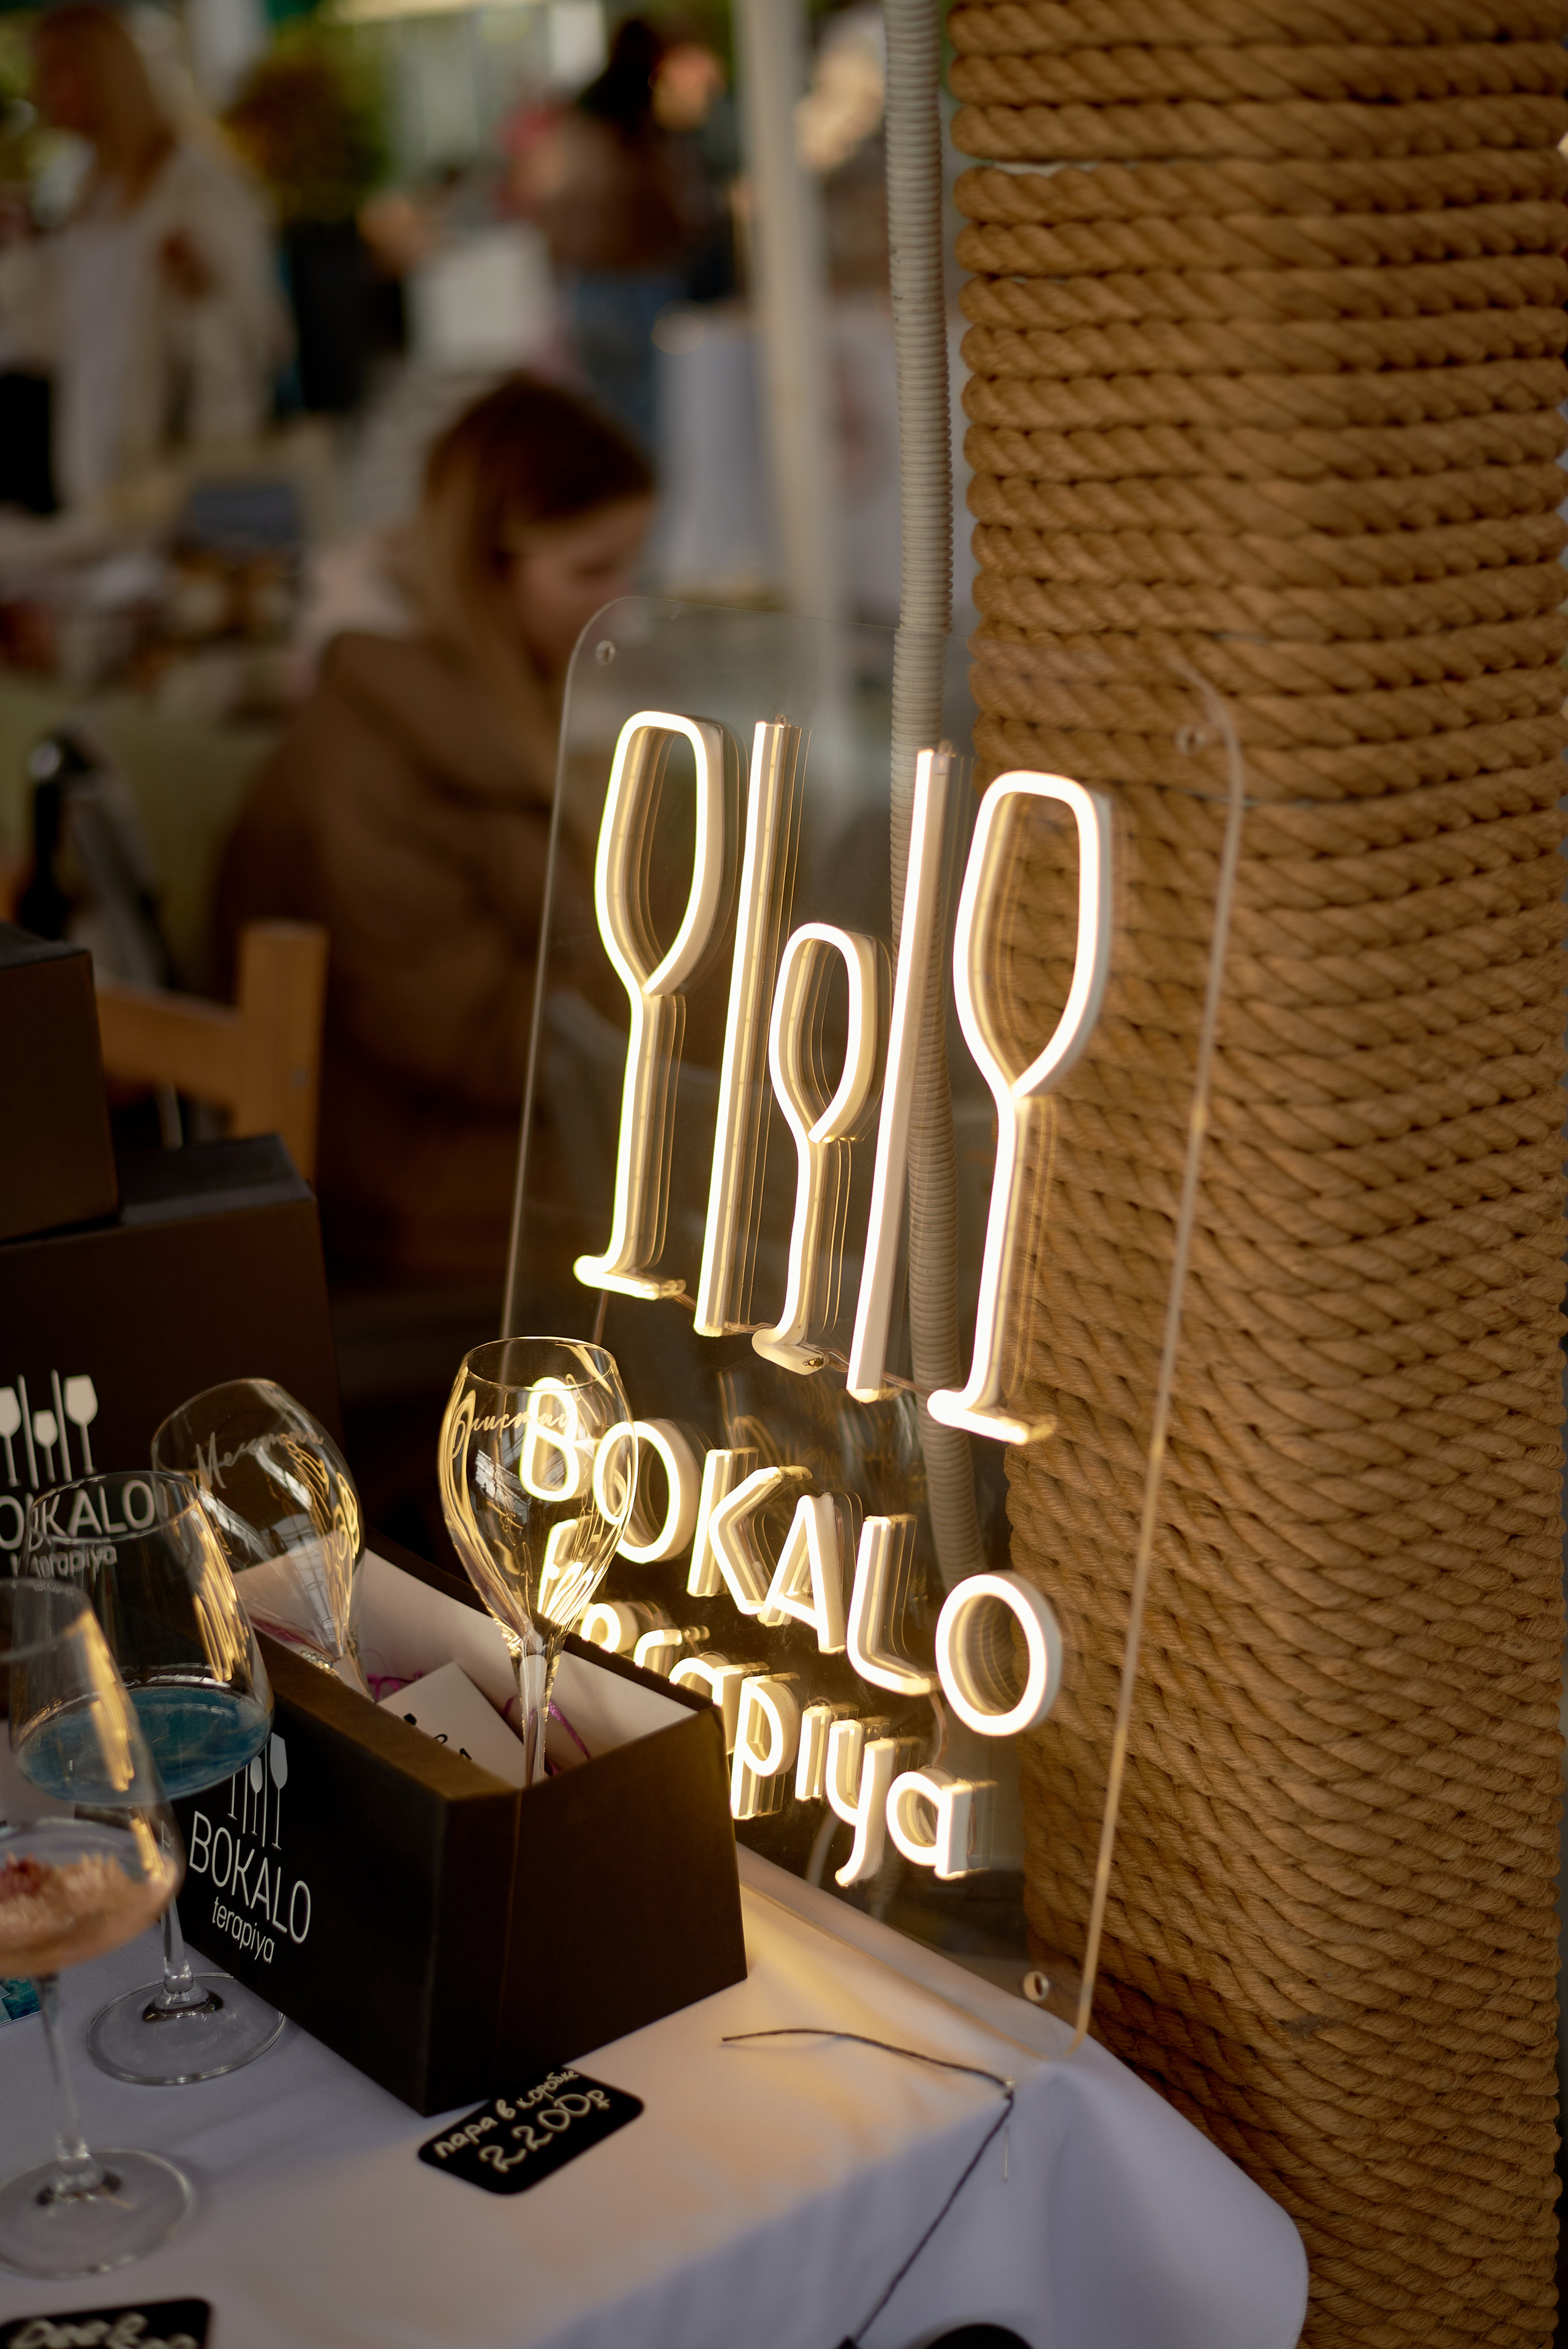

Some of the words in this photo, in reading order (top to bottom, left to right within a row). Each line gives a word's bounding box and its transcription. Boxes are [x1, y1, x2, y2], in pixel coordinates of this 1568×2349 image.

[519, 1377, 1060, 1736] BOKALO
[189, 1810, 311, 1944] BOKALO
[212, 1896, 275, 1964] terapiya
[432, 2116, 499, 2160] пара
[494, 2098, 516, 2121] в
